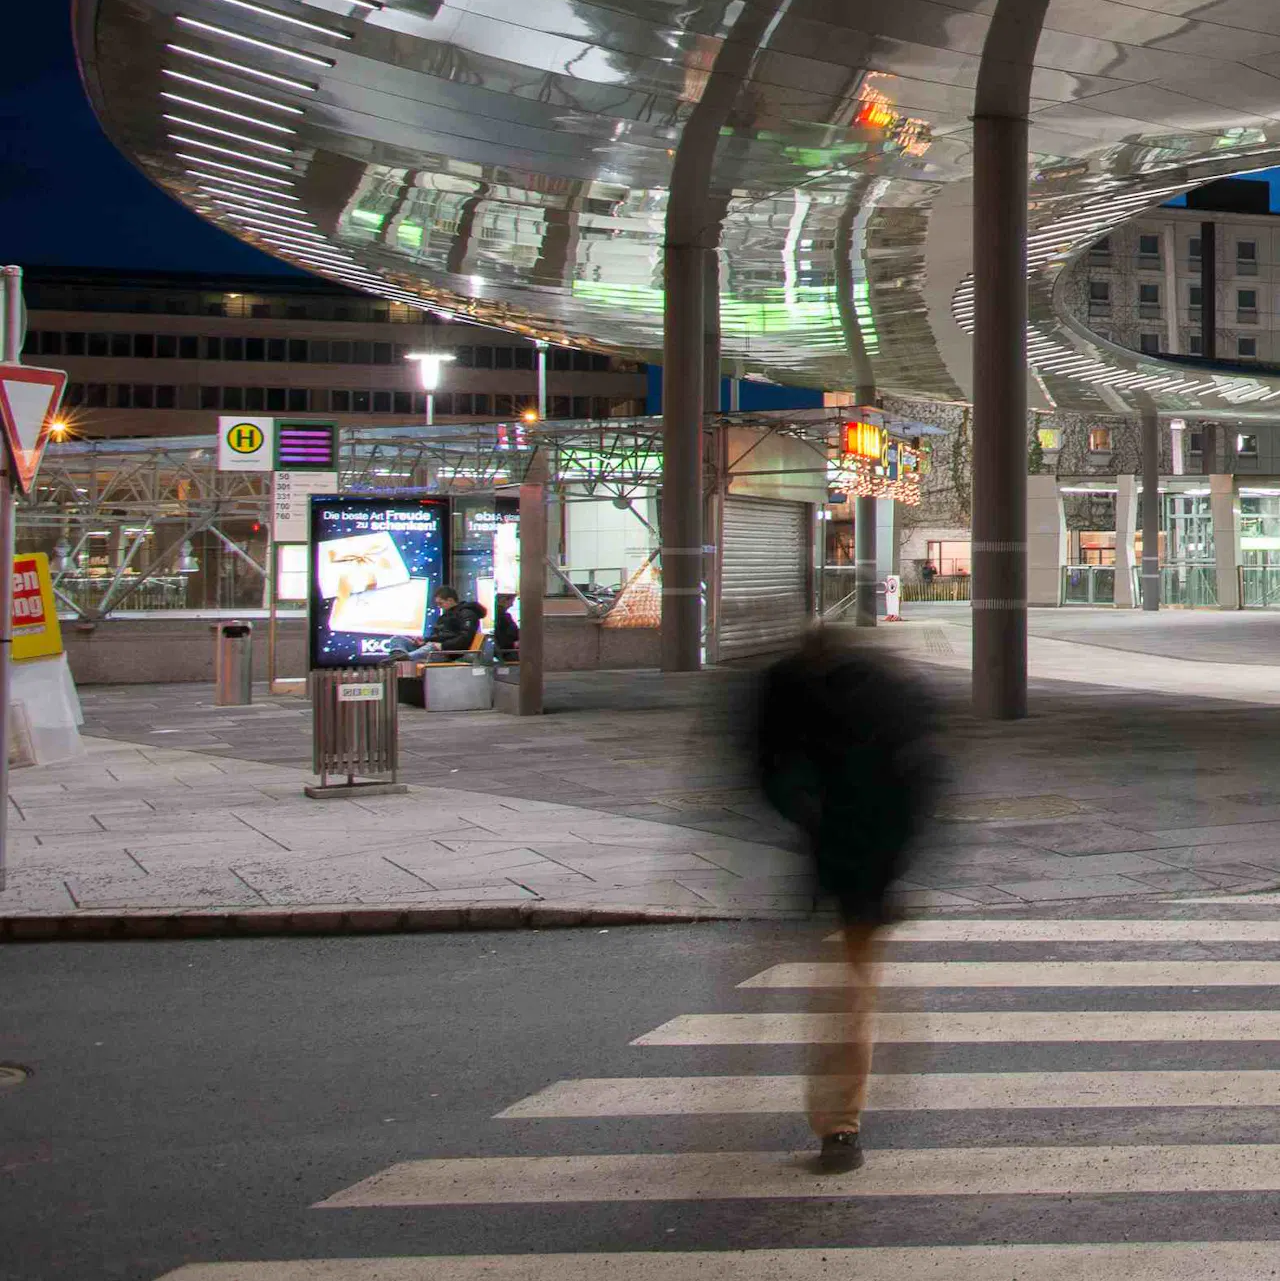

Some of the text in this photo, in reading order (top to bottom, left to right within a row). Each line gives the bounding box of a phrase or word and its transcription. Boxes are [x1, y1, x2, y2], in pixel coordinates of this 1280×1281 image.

[323, 509, 431, 521] Die beste Art Freude
[356, 521, 437, 531] zu schenken!
